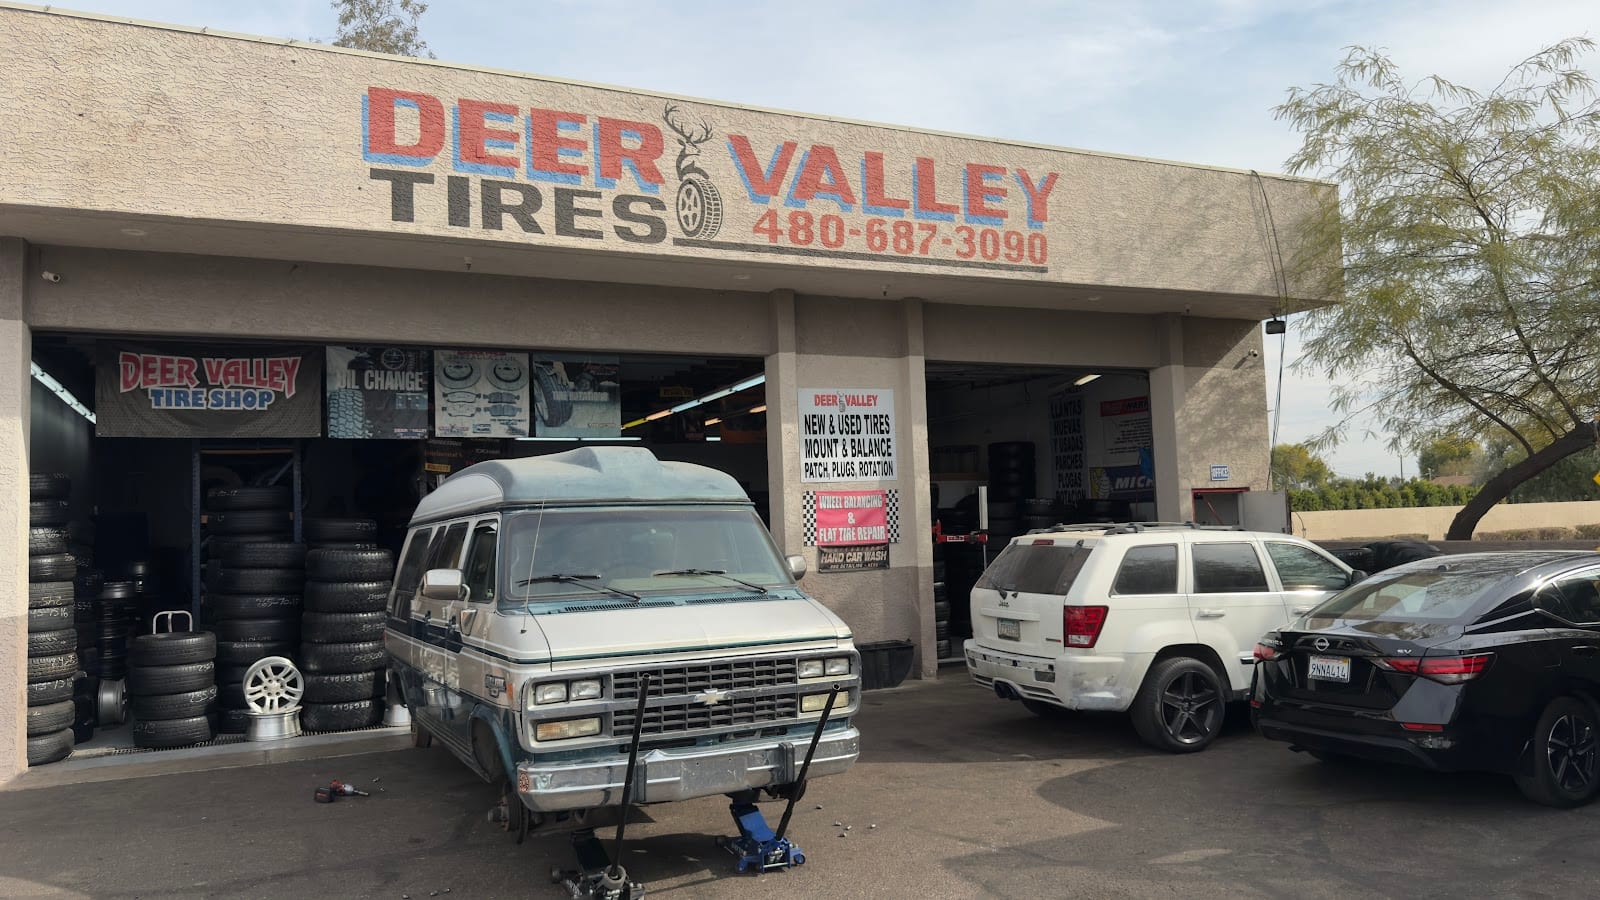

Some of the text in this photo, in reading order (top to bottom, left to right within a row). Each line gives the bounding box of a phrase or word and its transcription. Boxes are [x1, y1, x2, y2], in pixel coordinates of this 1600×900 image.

[363, 87, 1059, 228] DEER VALLEY
[369, 168, 667, 244] TIRES
[753, 207, 1048, 265] 480-687-3090
[119, 351, 302, 399] DEER VALLEY
[364, 369, 424, 391] CHANGE
[148, 387, 275, 410] TIRE SHOP
[814, 394, 878, 407] DEER VALLEY
[1050, 399, 1082, 419] LLANTAS
[804, 414, 890, 435] NEW & USED TIRES
[1054, 418, 1081, 436] NUEVAS
[804, 438, 892, 459] MOUNT & BALANCE
[1059, 435, 1084, 453] USADAS
[804, 460, 894, 480] PATCH, PLUGS, ROTATION
[1055, 453, 1084, 471] PARCHES
[819, 494, 883, 509] WHEEL BALANCING
[847, 511, 856, 524] &
[819, 526, 886, 542] FLAT TIRE REPAIR
[821, 550, 888, 564] HAND CAR WASH
[1311, 663, 1347, 678] 9NNA414
